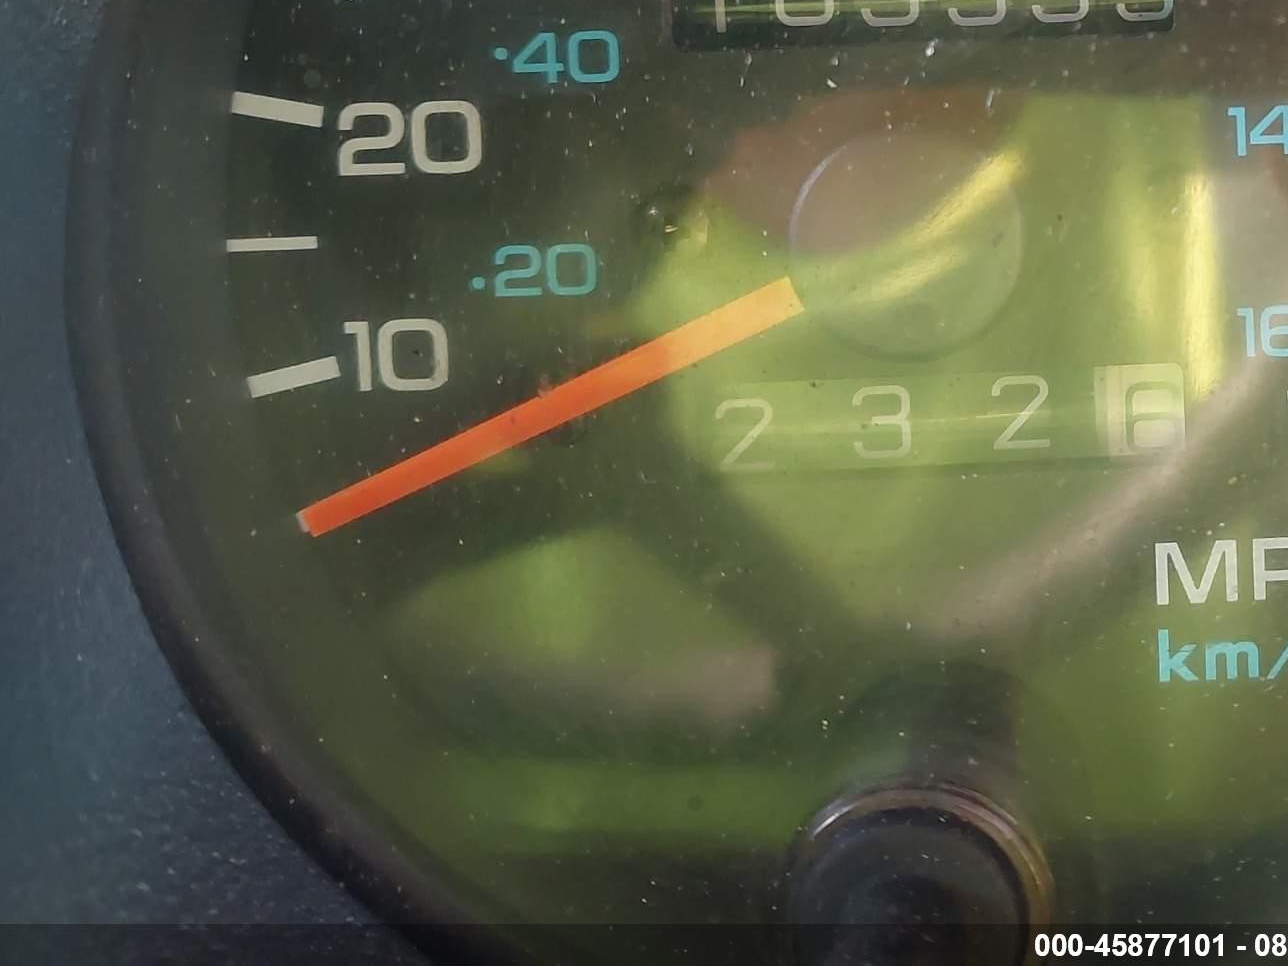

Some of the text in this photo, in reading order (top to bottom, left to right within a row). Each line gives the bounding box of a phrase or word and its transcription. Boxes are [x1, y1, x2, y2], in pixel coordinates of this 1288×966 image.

[512, 30, 621, 84] 40
[337, 99, 484, 177] 20
[493, 243, 598, 297] 20
[343, 317, 450, 392] 10
